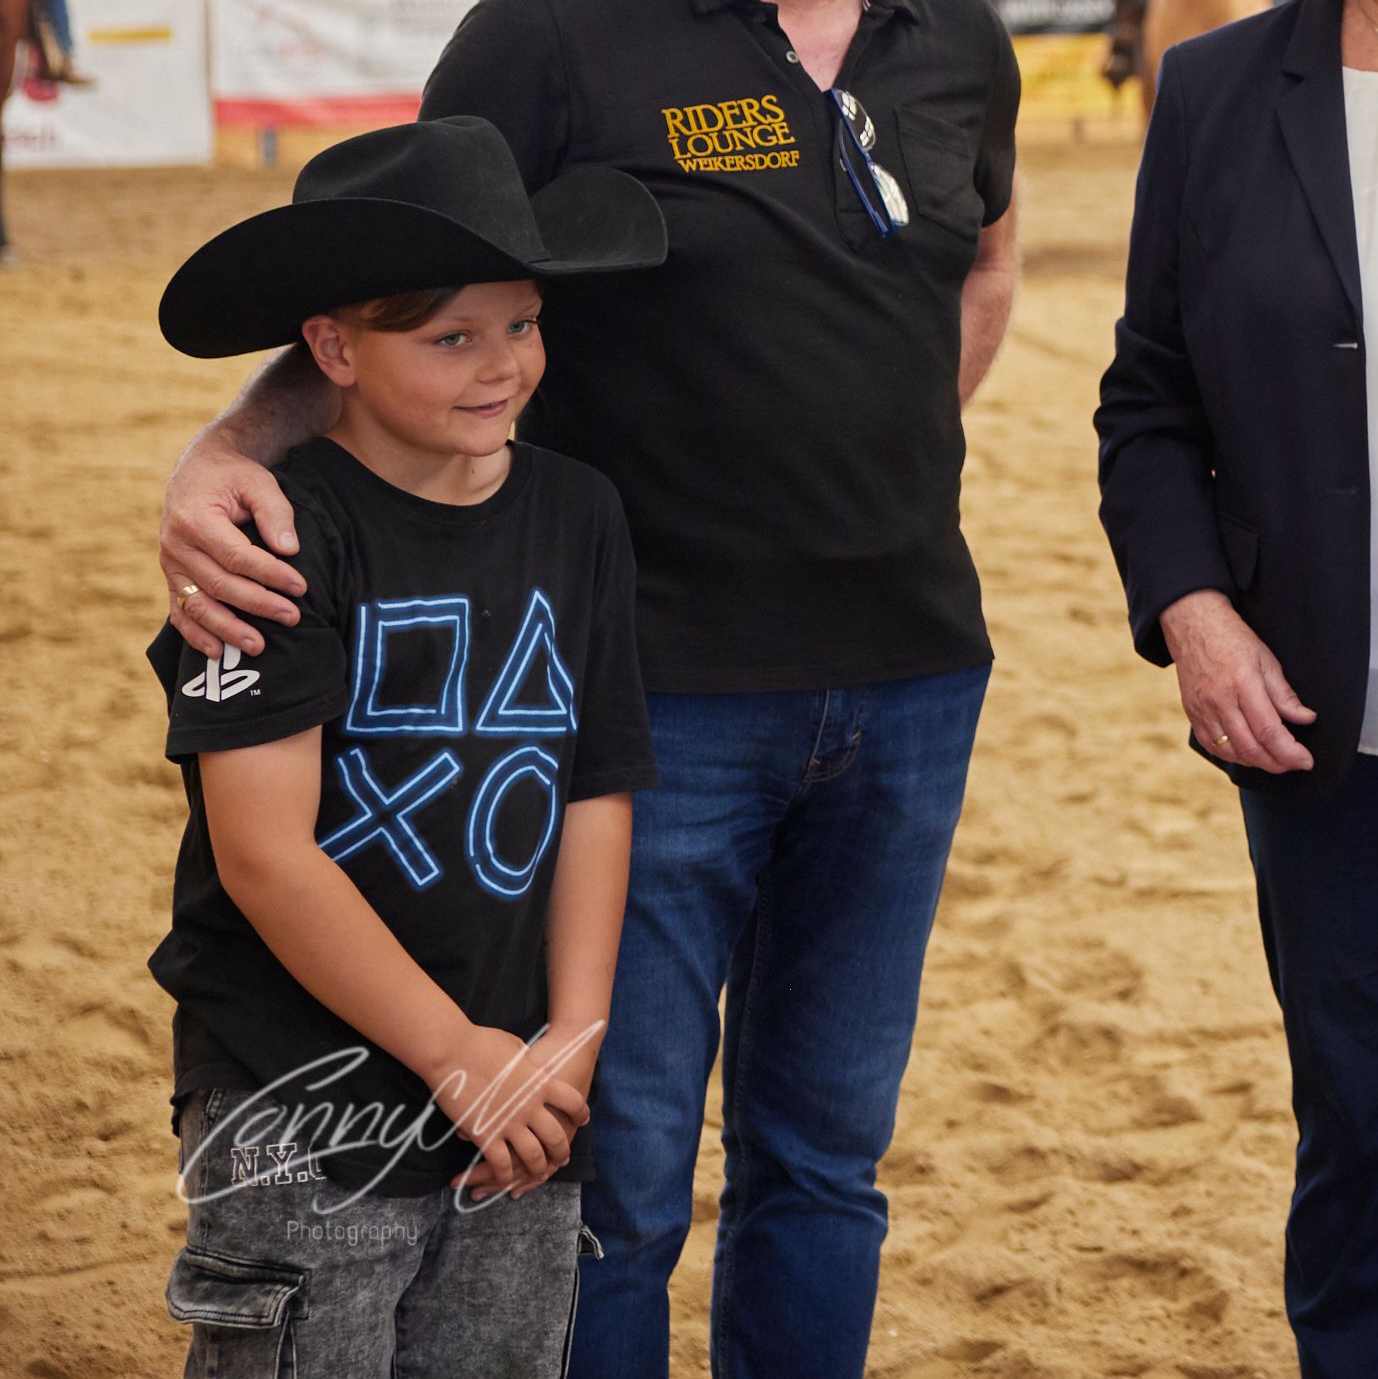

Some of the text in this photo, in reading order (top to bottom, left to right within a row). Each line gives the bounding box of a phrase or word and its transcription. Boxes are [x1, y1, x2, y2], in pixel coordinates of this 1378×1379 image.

[661, 94, 785, 140] RIDERS
[668, 121, 797, 160] LOUNGE
[677, 149, 800, 173] WEIKERSDORF
